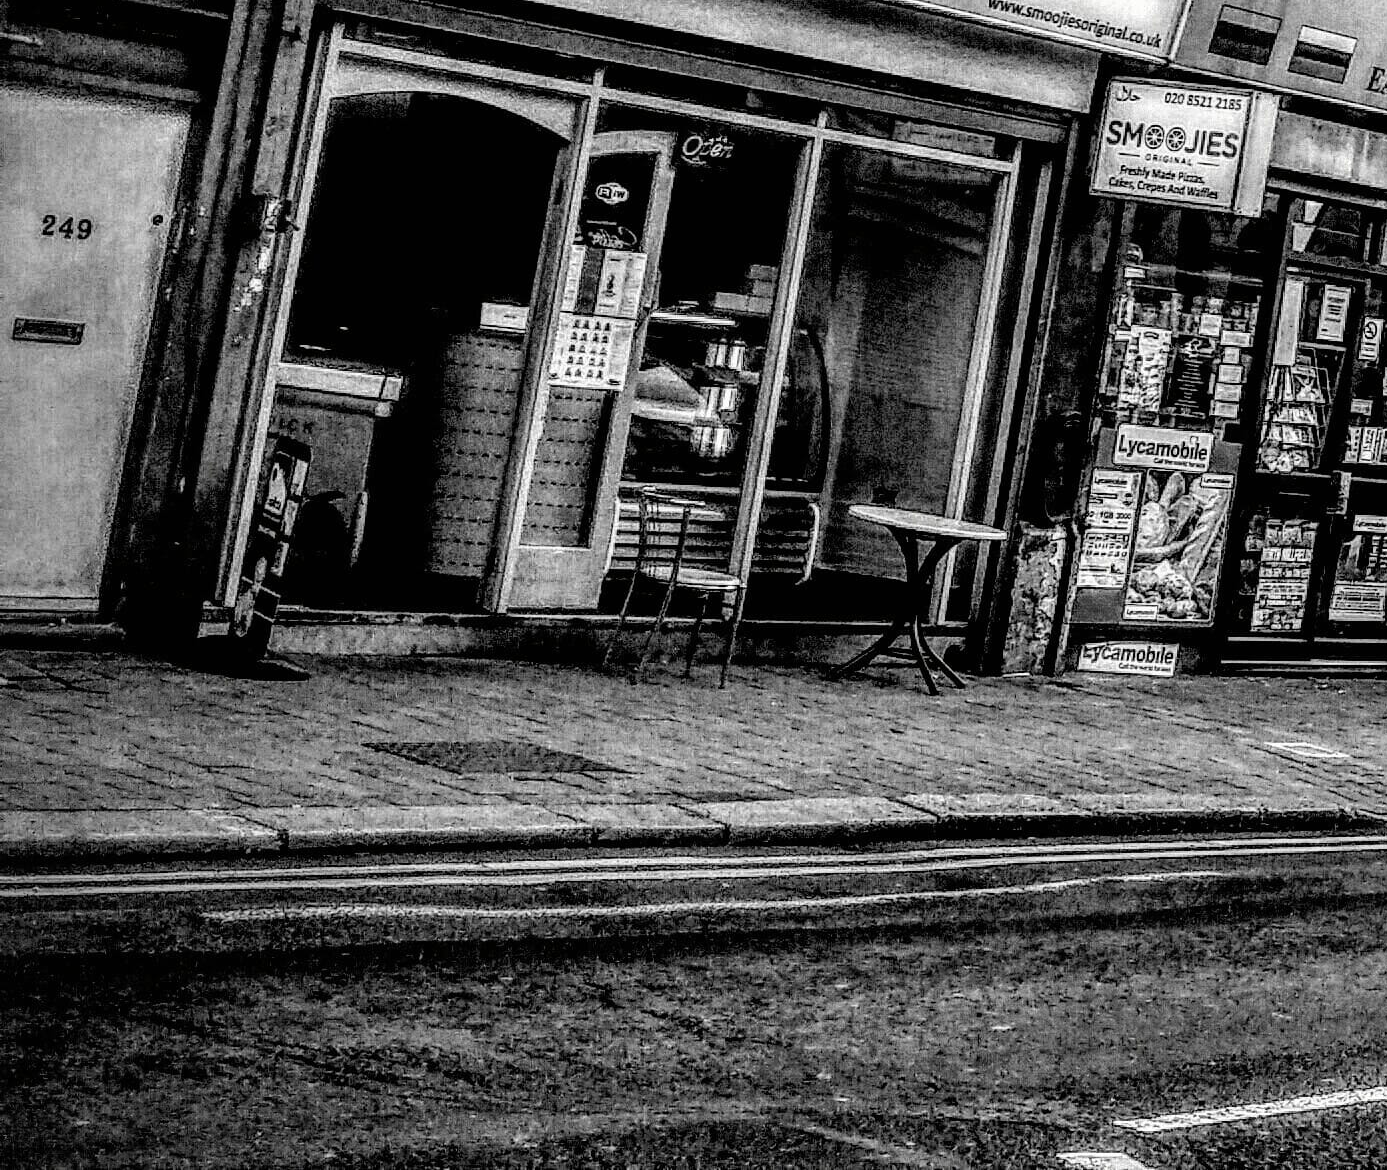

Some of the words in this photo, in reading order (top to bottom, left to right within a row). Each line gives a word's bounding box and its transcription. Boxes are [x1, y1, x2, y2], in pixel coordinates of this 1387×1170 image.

[1164, 92, 1185, 105] 020
[1106, 120, 1240, 159] SMOOJIES
[1144, 153, 1193, 167] ORIGINAL
[41, 214, 93, 241] 249
[1118, 434, 1208, 461] Lycamobile
[1082, 645, 1174, 664] Lycamobile
